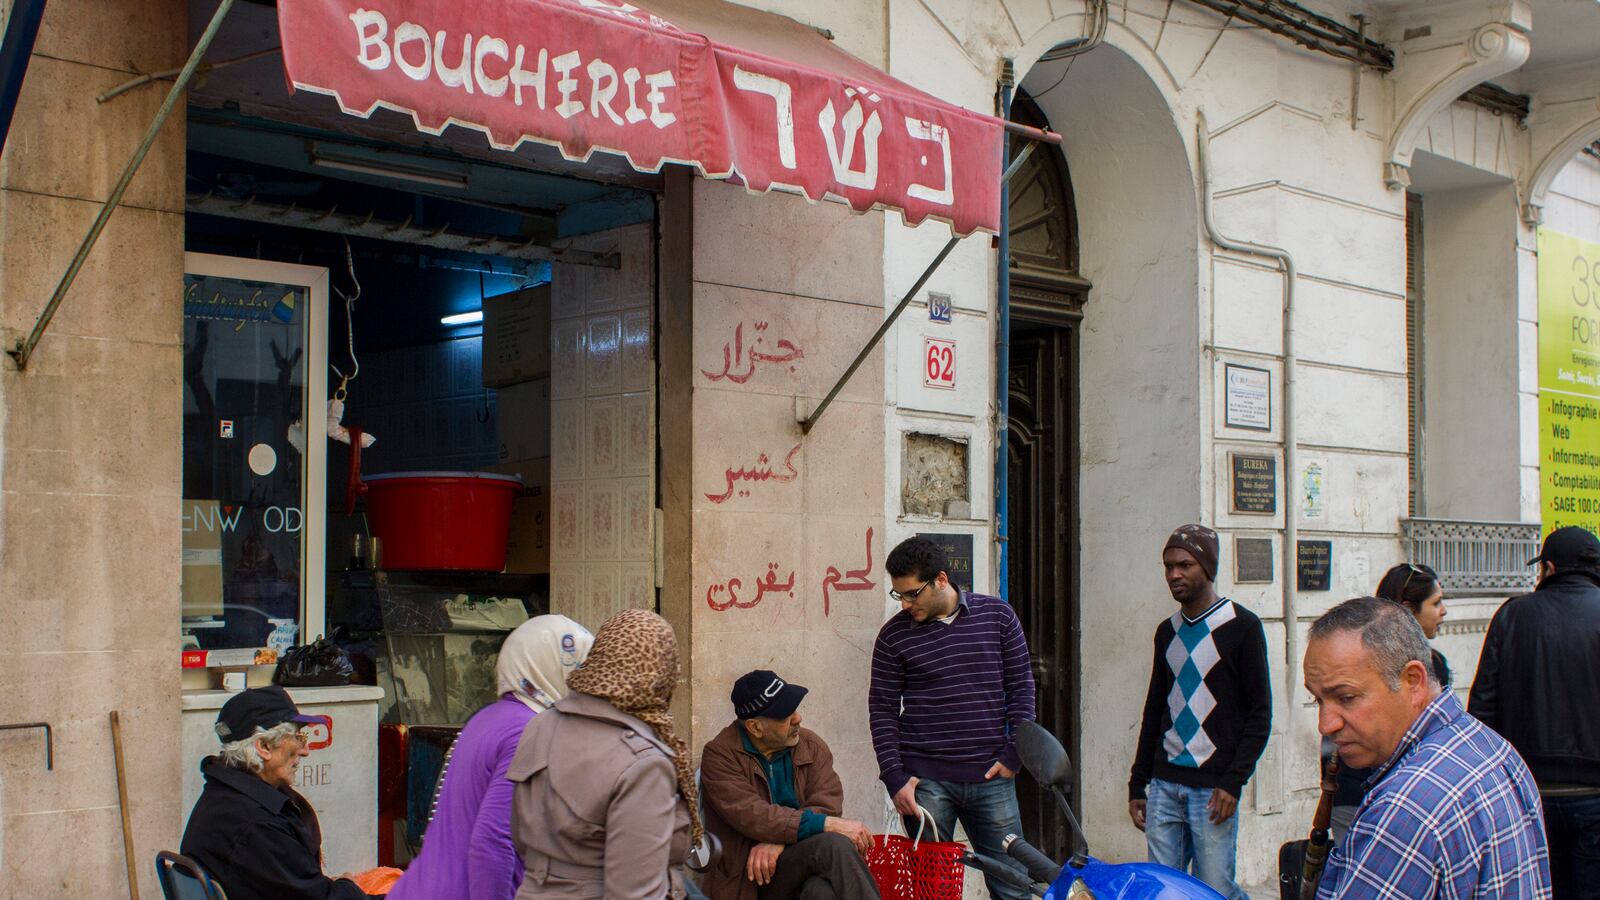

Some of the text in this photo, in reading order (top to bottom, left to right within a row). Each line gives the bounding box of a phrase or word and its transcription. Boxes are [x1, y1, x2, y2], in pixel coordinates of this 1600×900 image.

[349, 8, 677, 130] BOUCHERIE
[931, 299, 949, 319] 62
[1572, 315, 1600, 345] FOR
[927, 345, 953, 381] 62
[1552, 399, 1598, 421] Infographie
[1552, 423, 1570, 440] Web
[1243, 458, 1268, 470] EUREKA
[1552, 447, 1600, 470] Informatiqu
[1553, 496, 1576, 513] SAGE
[1578, 498, 1592, 513] 100
[822, 526, 877, 618] لحم
